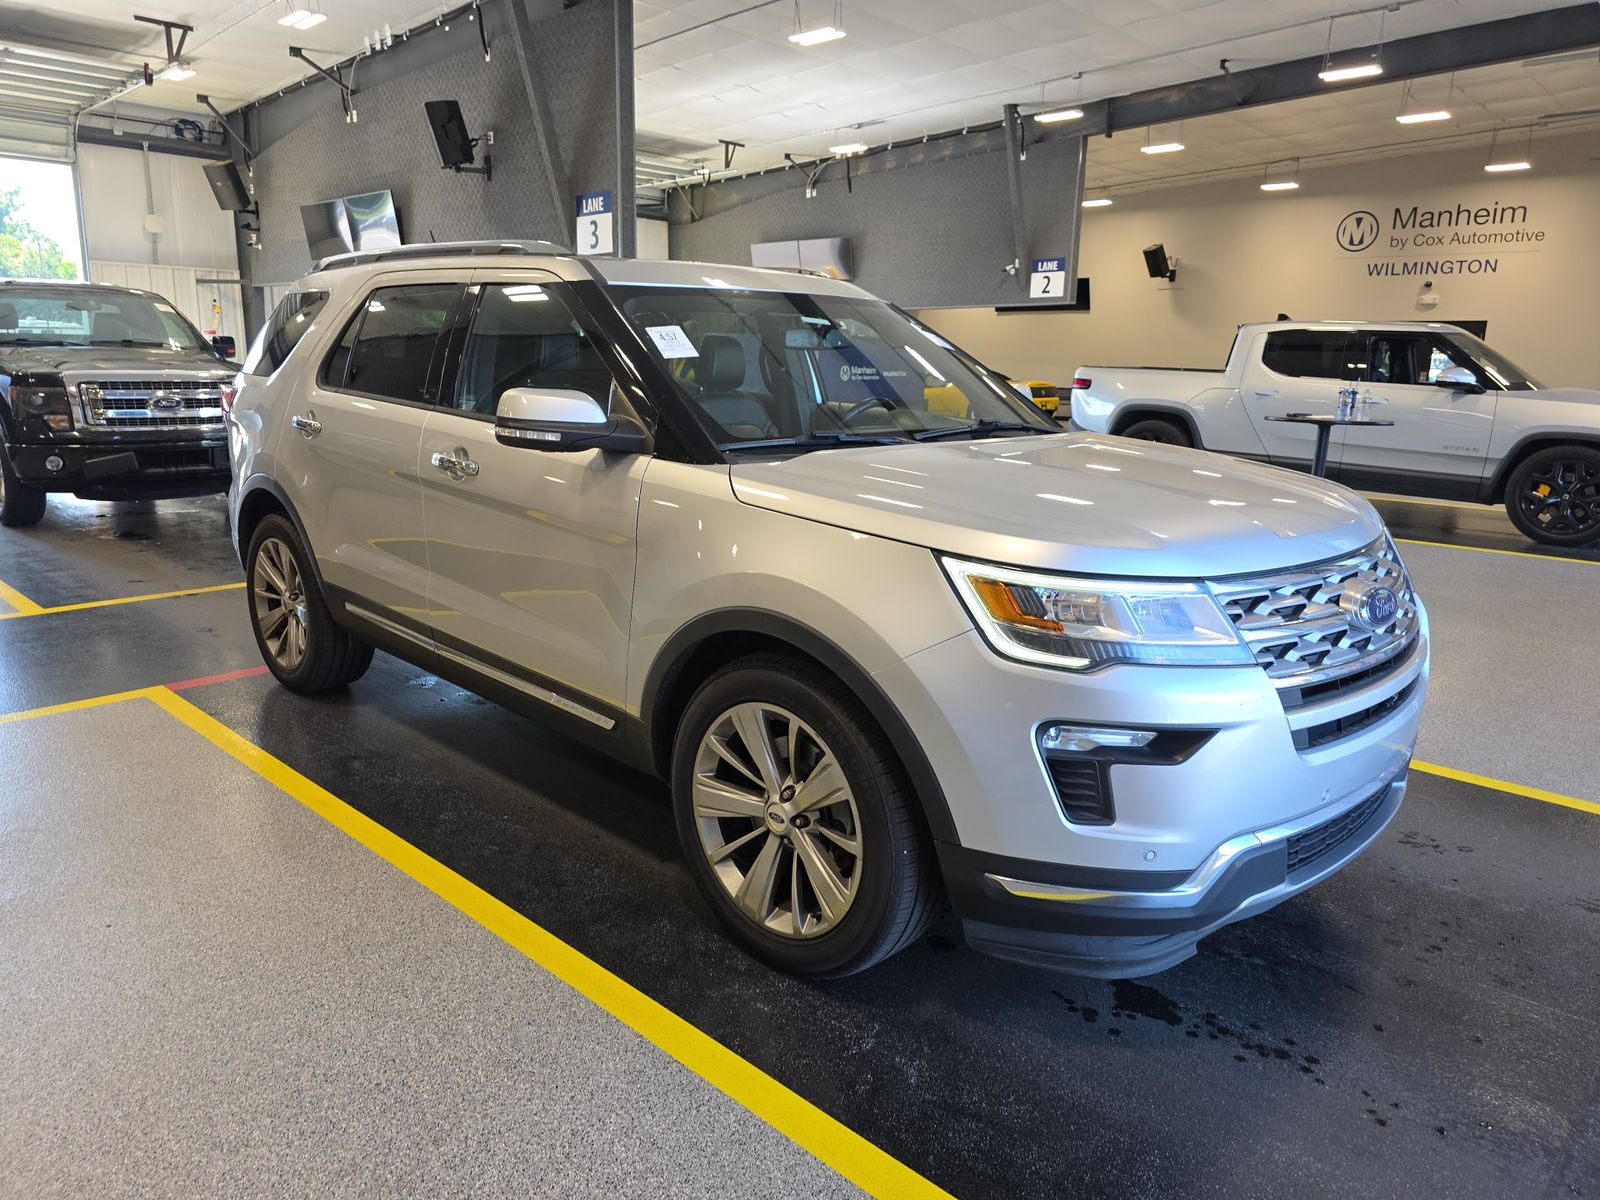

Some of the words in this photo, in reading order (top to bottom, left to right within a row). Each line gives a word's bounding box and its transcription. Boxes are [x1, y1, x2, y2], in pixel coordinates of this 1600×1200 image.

[582, 196, 604, 214] LANE
[1392, 201, 1528, 230] Manheim
[589, 219, 599, 250] 3
[1389, 235, 1408, 250] by
[1413, 233, 1444, 247] Cox
[1449, 228, 1545, 246] Automotive
[1037, 260, 1059, 272] LANE
[1367, 259, 1498, 277] WILMINGTON
[1041, 275, 1051, 294] 2
[1375, 595, 1396, 618] Ford
